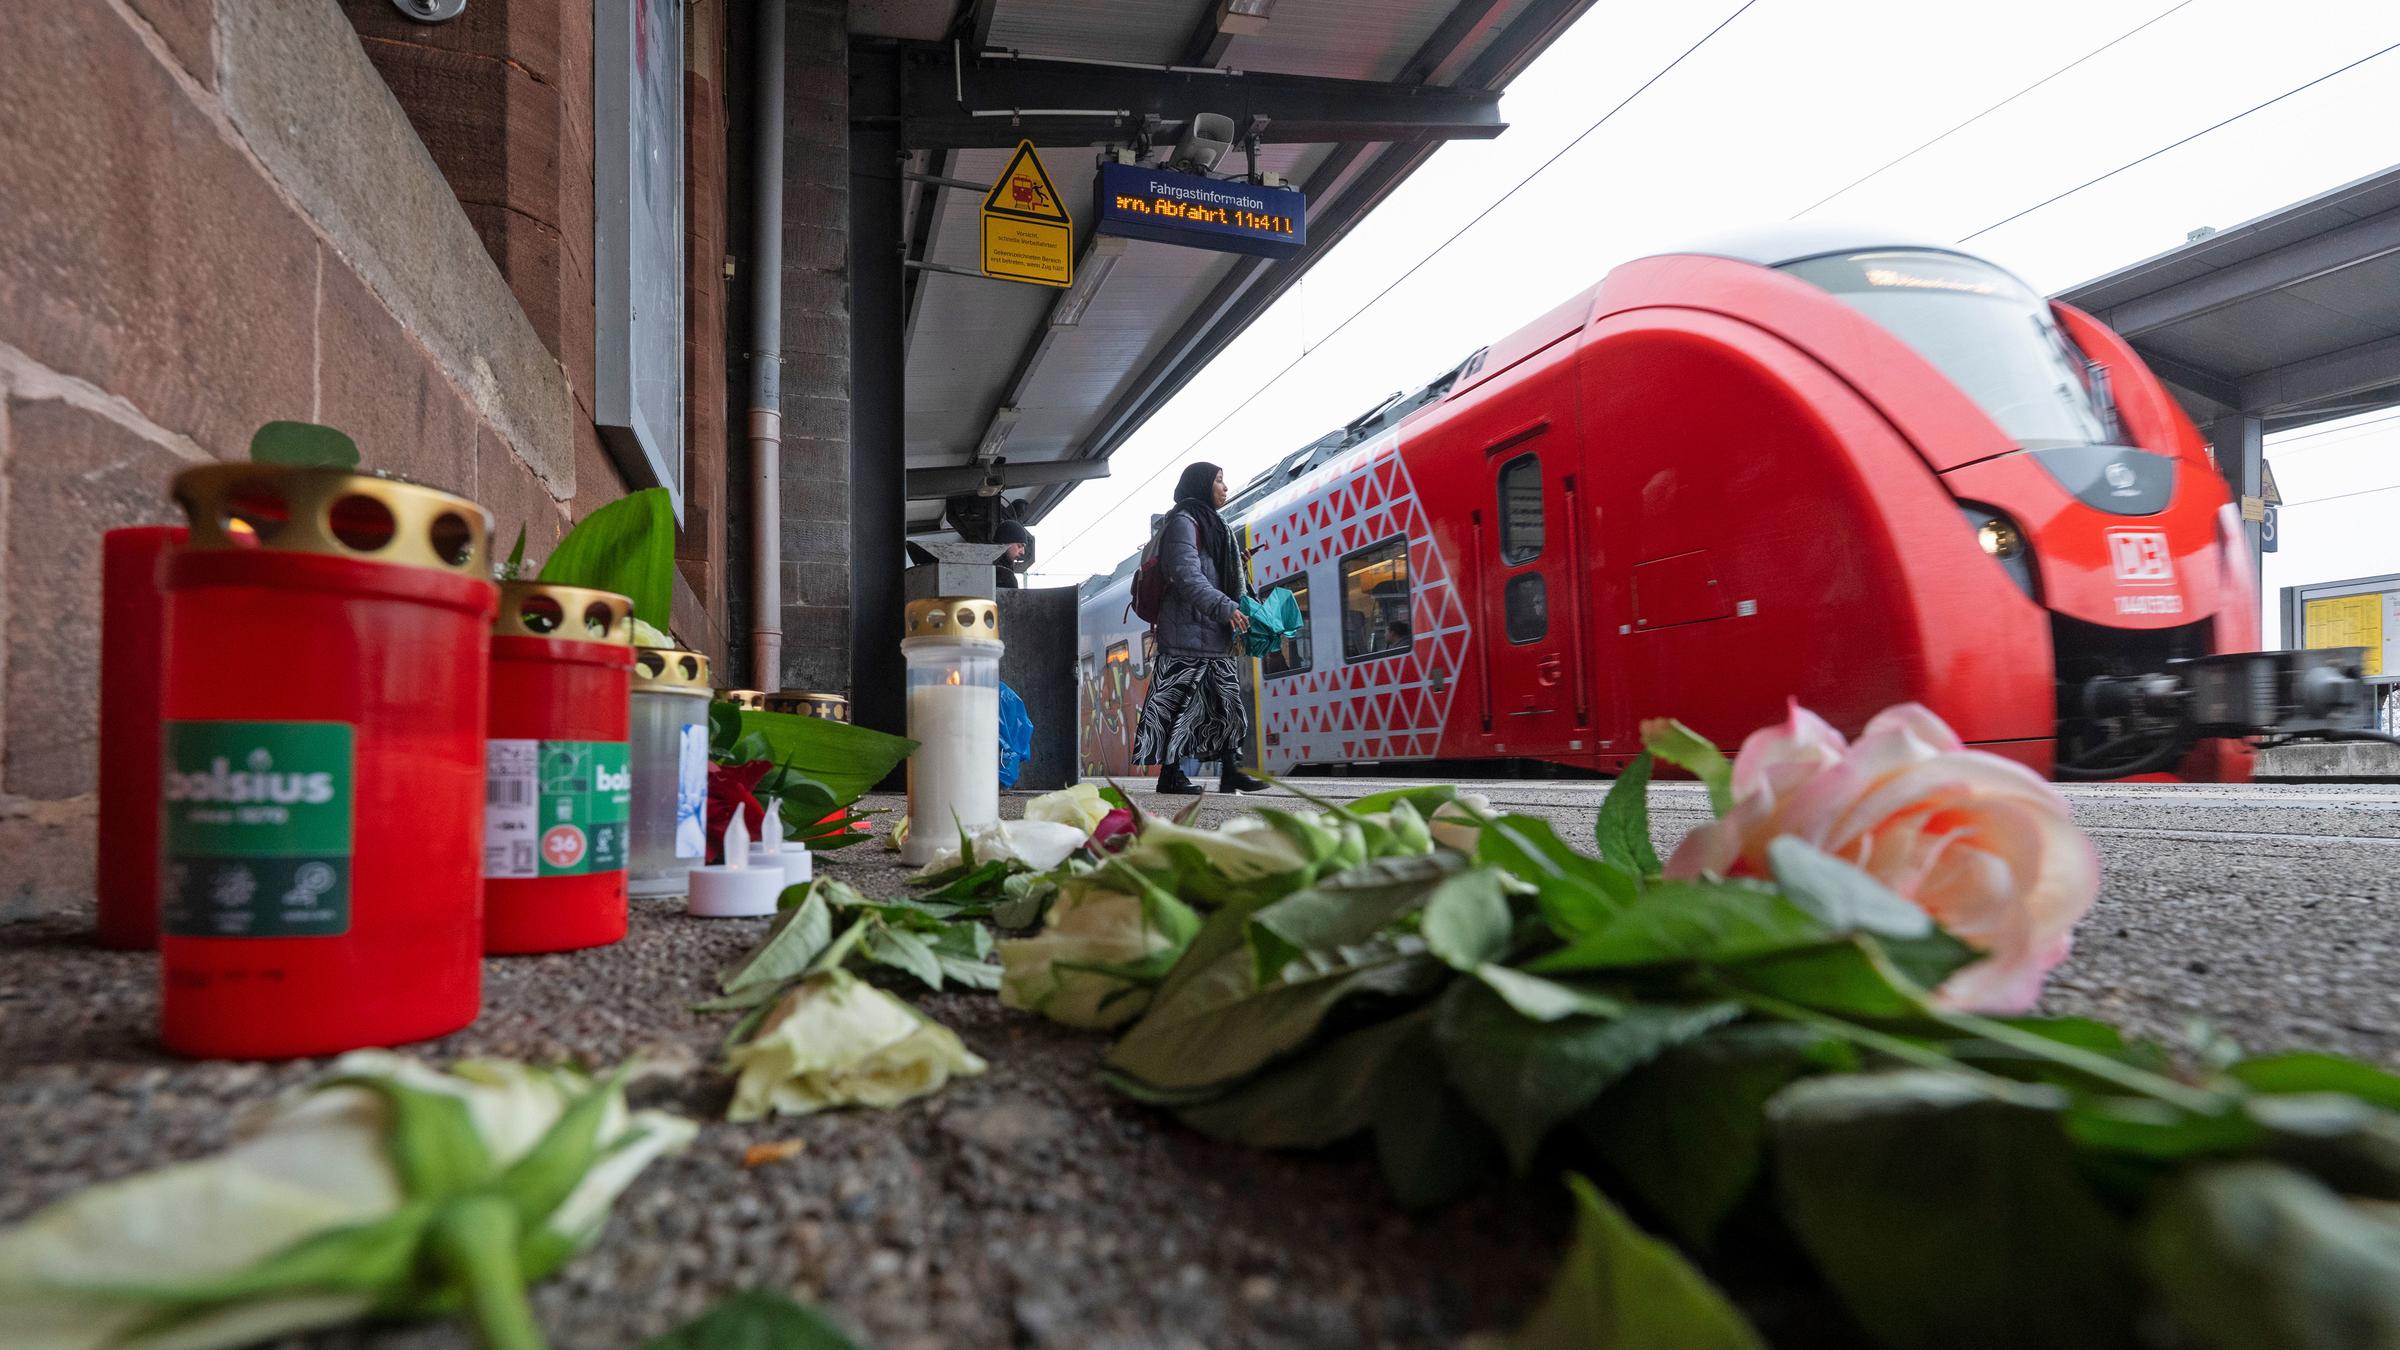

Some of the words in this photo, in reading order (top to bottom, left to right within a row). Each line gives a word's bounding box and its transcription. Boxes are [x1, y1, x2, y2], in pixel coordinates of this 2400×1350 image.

[1150, 181, 1264, 210] Fahrgastinformation
[1154, 199, 1228, 225] Abfahrt
[1235, 210, 1280, 232] 11:41
[2262, 508, 2275, 542] 3
[2106, 531, 2175, 580] DB
[549, 834, 578, 853] 36
